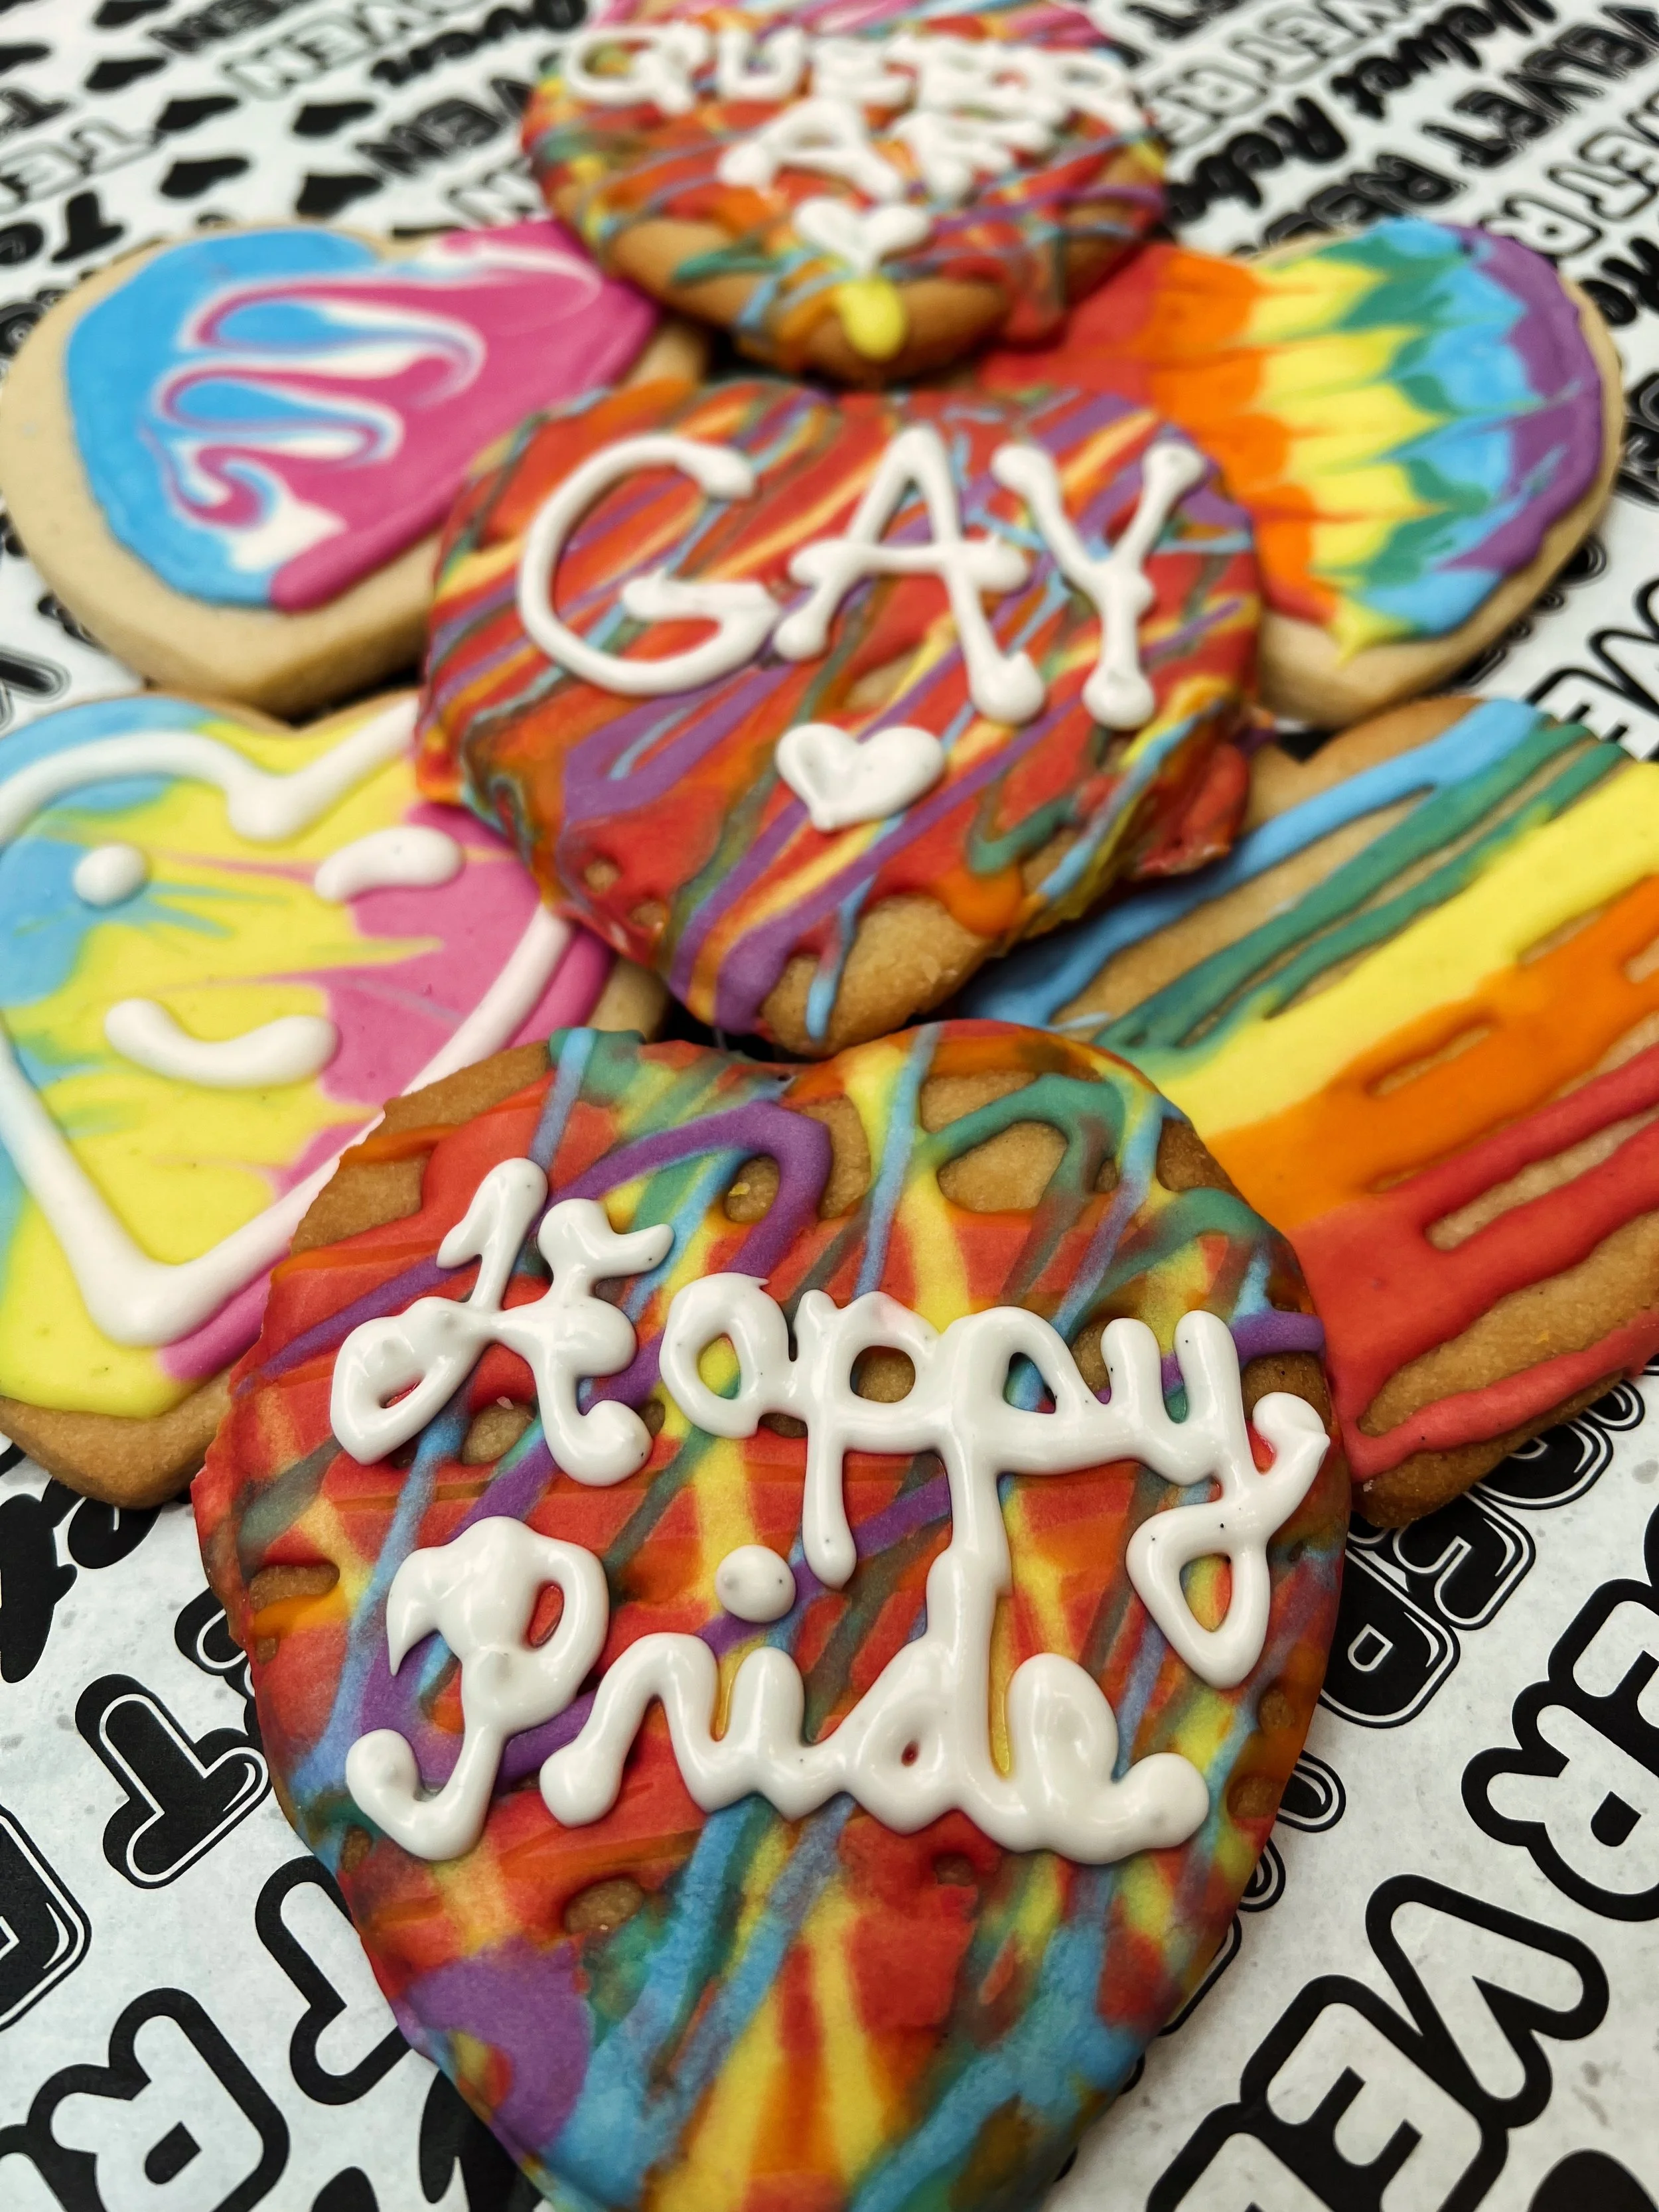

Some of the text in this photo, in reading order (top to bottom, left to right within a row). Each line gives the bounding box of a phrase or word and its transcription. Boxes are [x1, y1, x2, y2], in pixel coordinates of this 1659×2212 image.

[516, 427, 1207, 729] GAY
[330, 1157, 1331, 1689] Happy
[346, 1514, 1210, 1866] Pride
